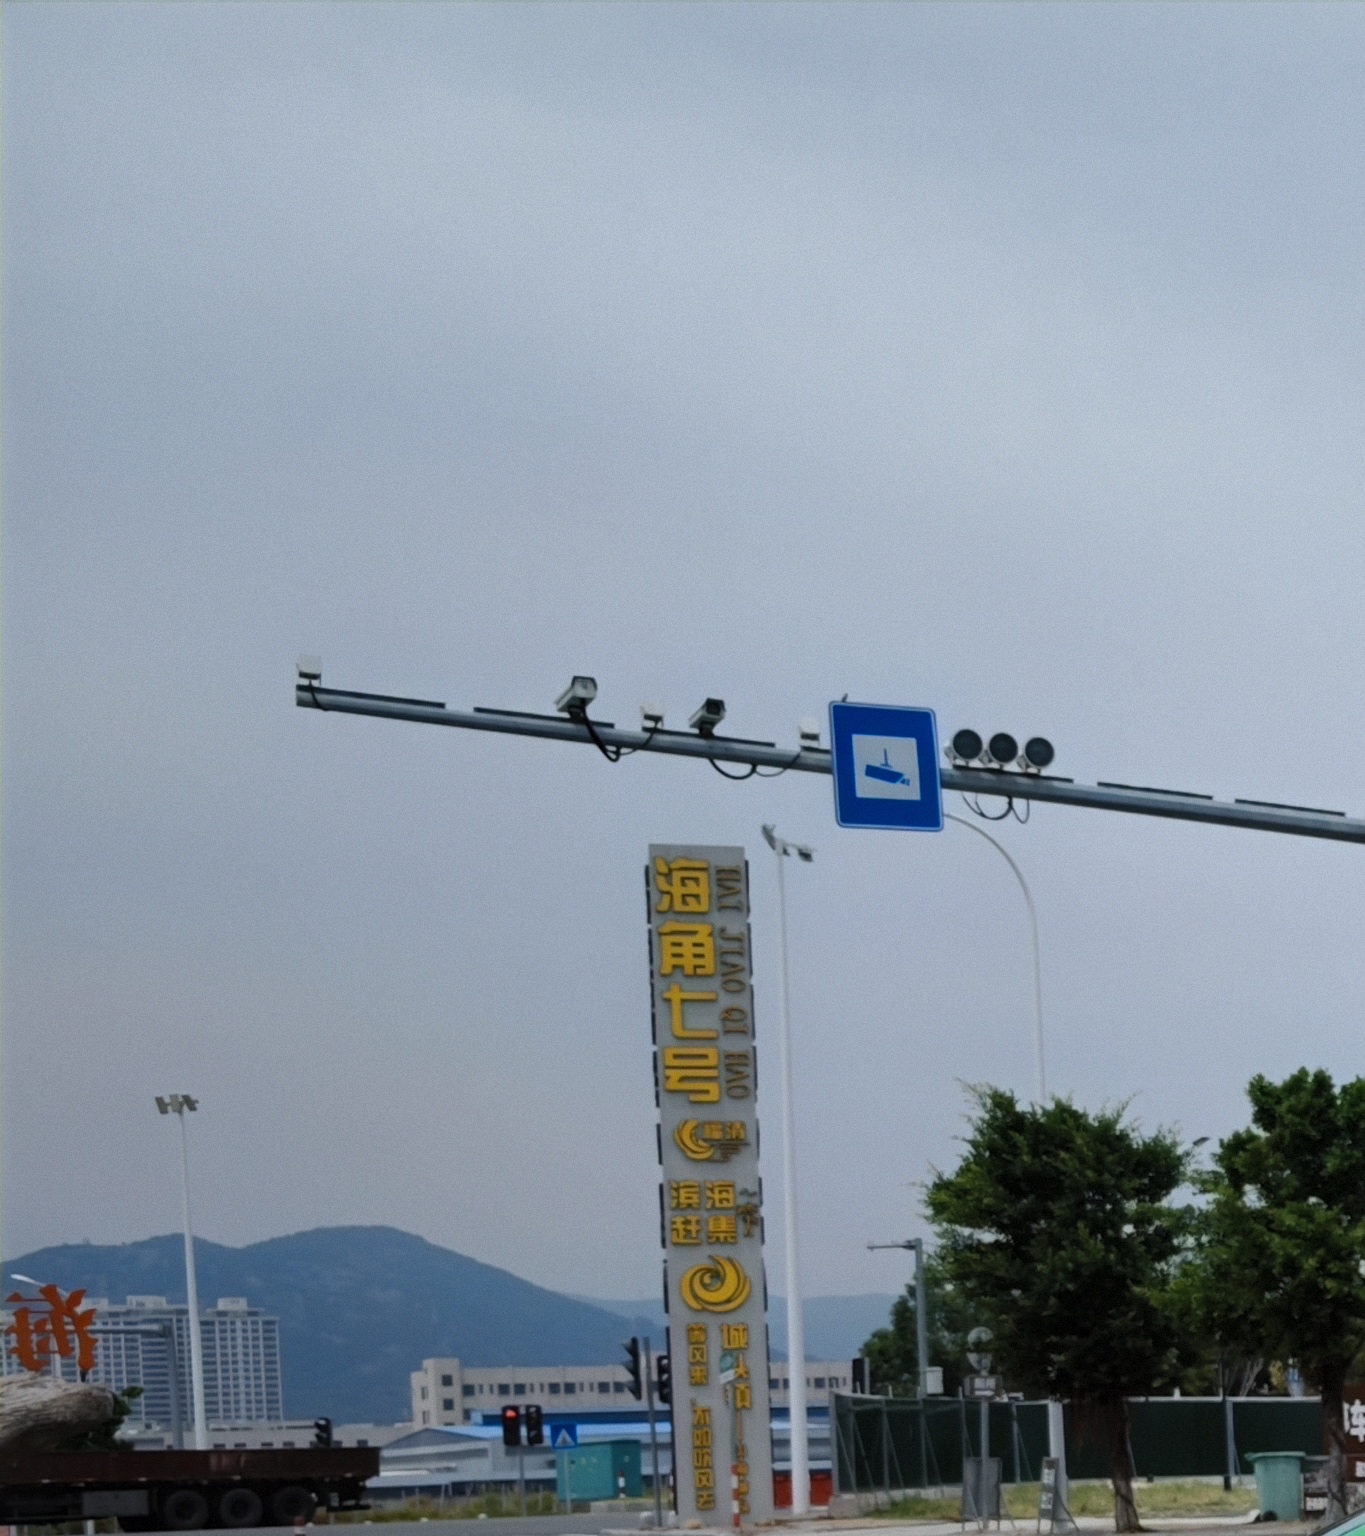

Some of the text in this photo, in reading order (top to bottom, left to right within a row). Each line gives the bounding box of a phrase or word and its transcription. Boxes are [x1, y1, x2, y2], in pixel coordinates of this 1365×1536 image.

[656, 858, 720, 1102] 海角七号
[717, 867, 750, 1100] HAI JIAO QI HAO
[670, 1179, 736, 1210] 滨海
[670, 1214, 738, 1246] 赶集
